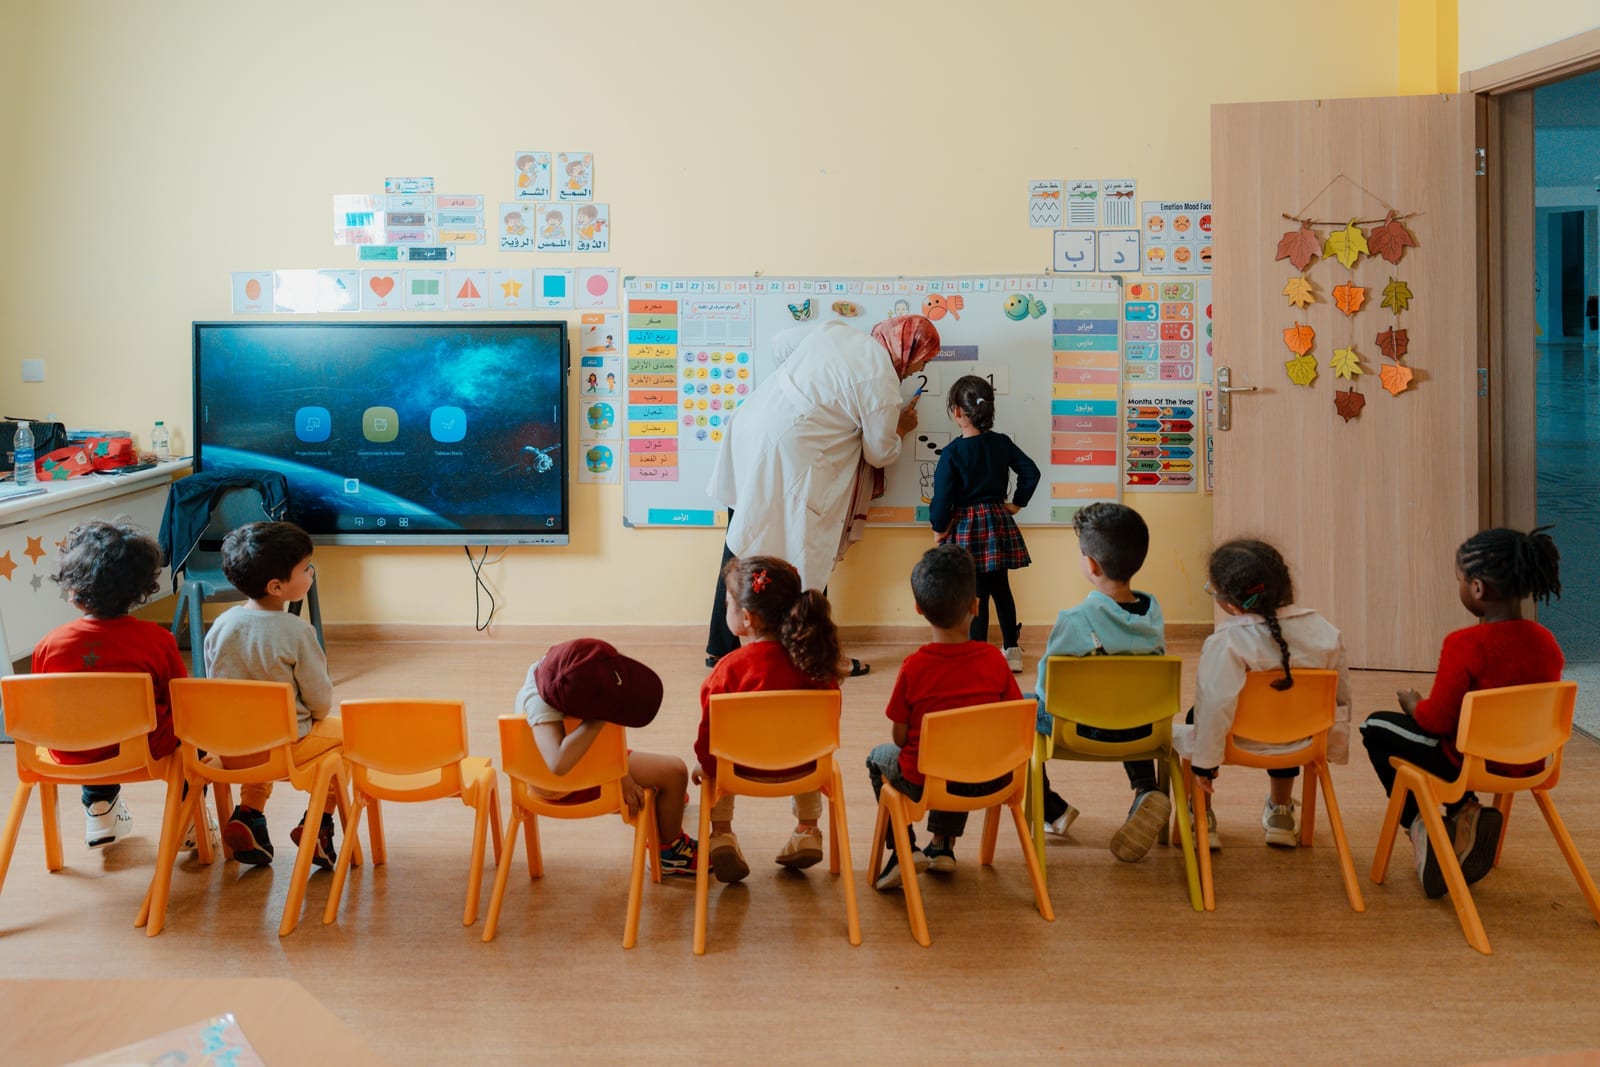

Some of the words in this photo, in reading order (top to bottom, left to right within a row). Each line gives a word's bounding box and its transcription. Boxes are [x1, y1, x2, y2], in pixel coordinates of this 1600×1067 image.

[560, 188, 591, 200] السمع
[537, 239, 571, 249] اللمس
[1065, 250, 1084, 268] ب
[1113, 251, 1125, 264] د
[1148, 285, 1155, 298] 1
[1181, 285, 1191, 299] 2
[1147, 304, 1157, 319] 3
[1179, 304, 1190, 319] 4
[1147, 324, 1157, 339] 5
[1180, 324, 1191, 339] 6
[1147, 344, 1157, 359] 7
[1180, 344, 1190, 359] 8
[1177, 364, 1192, 378] 10
[917, 375, 928, 392] 2
[986, 373, 997, 391] 1
